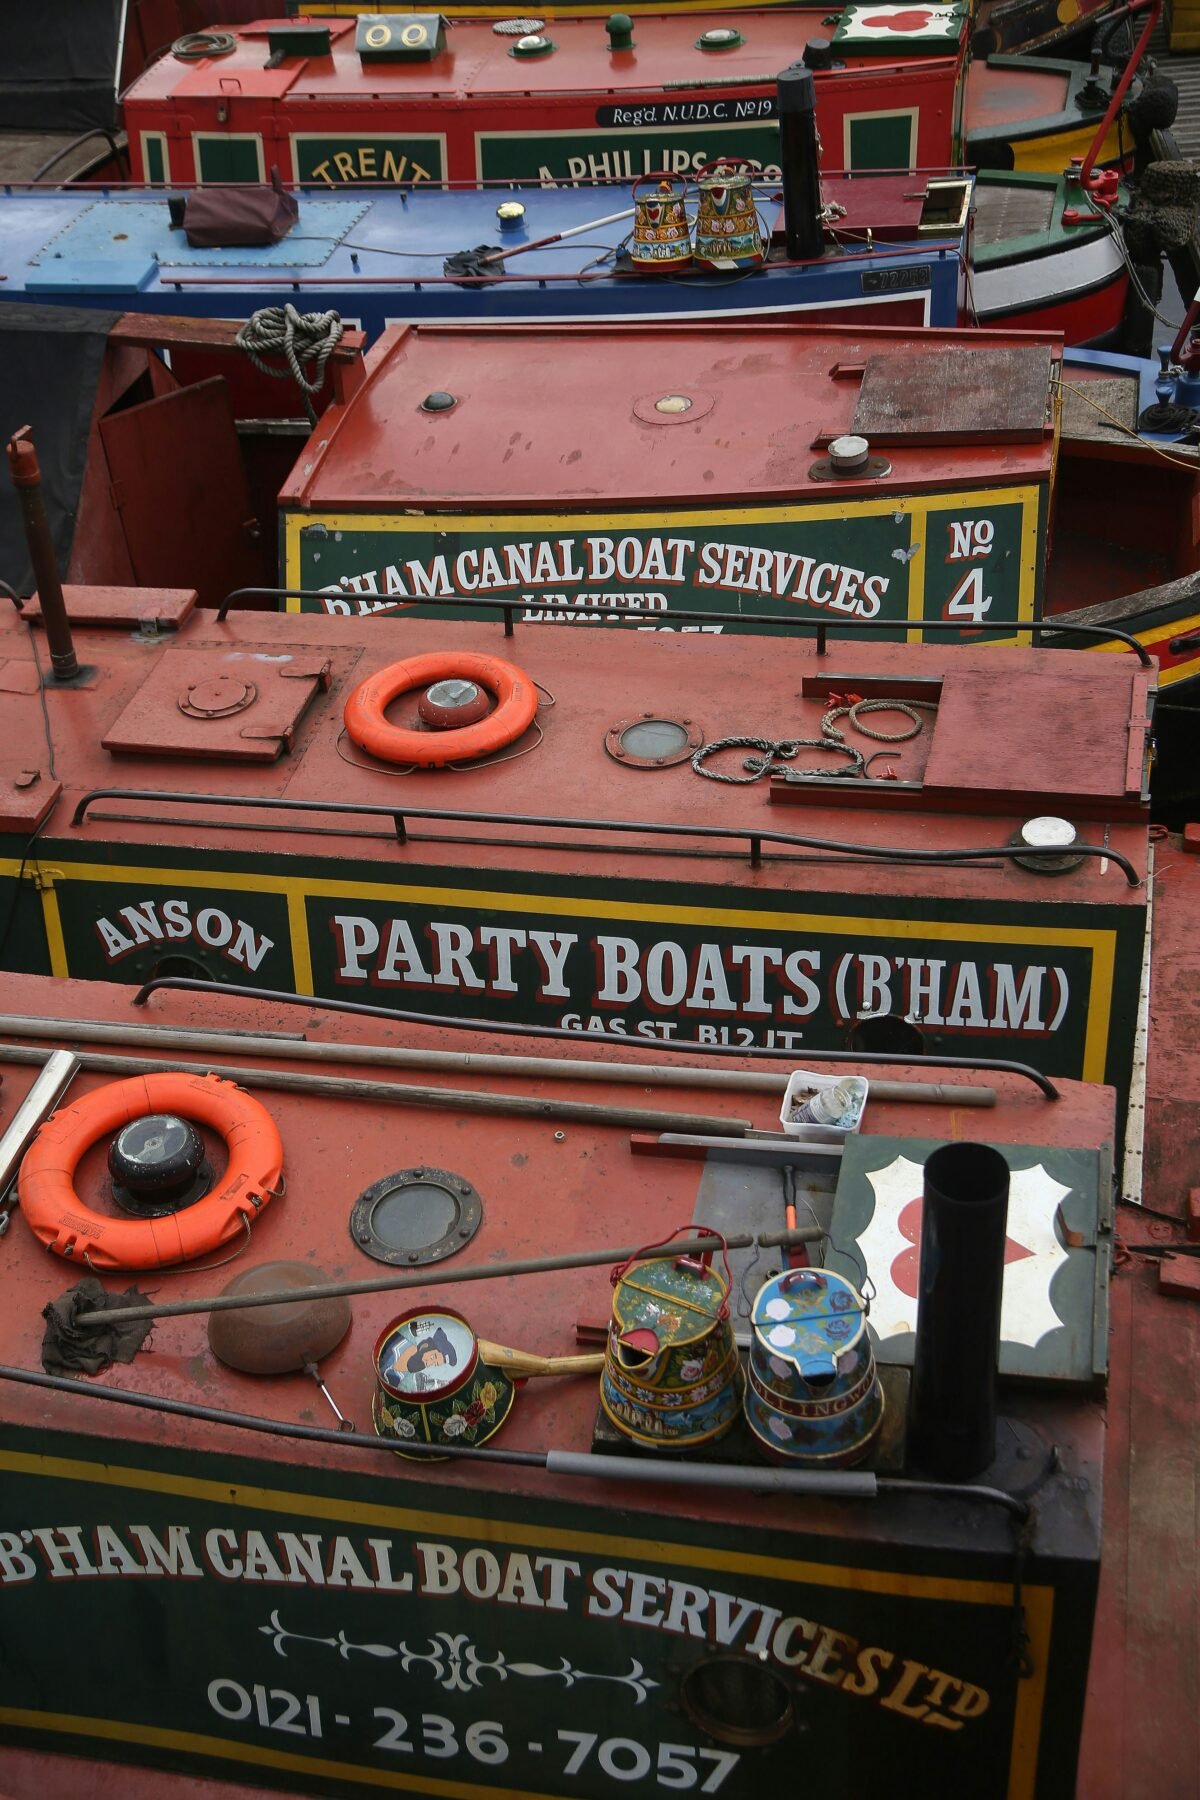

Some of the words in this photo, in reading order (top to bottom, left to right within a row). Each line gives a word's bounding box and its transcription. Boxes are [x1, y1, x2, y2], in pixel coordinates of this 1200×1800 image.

[311, 147, 432, 190] TRENT
[457, 539, 584, 591] CANAL
[588, 536, 696, 582] BOAT
[698, 542, 890, 619] SERVICES
[521, 592, 669, 622] LIMITED
[947, 566, 993, 623] 4
[96, 899, 275, 973] ANSON
[335, 915, 579, 997] PARTY
[597, 935, 821, 1016] BOATS
[835, 952, 1070, 1032] (B'HAM)
[561, 1013, 627, 1036] GAS
[0, 1525, 205, 1583] B'HAM
[206, 1528, 414, 1592] CANAL
[417, 1541, 582, 1611] BOAT
[588, 1567, 895, 1697] SERVICES
[373, 1707, 509, 1765] 236
[557, 1730, 741, 1794] 7057
